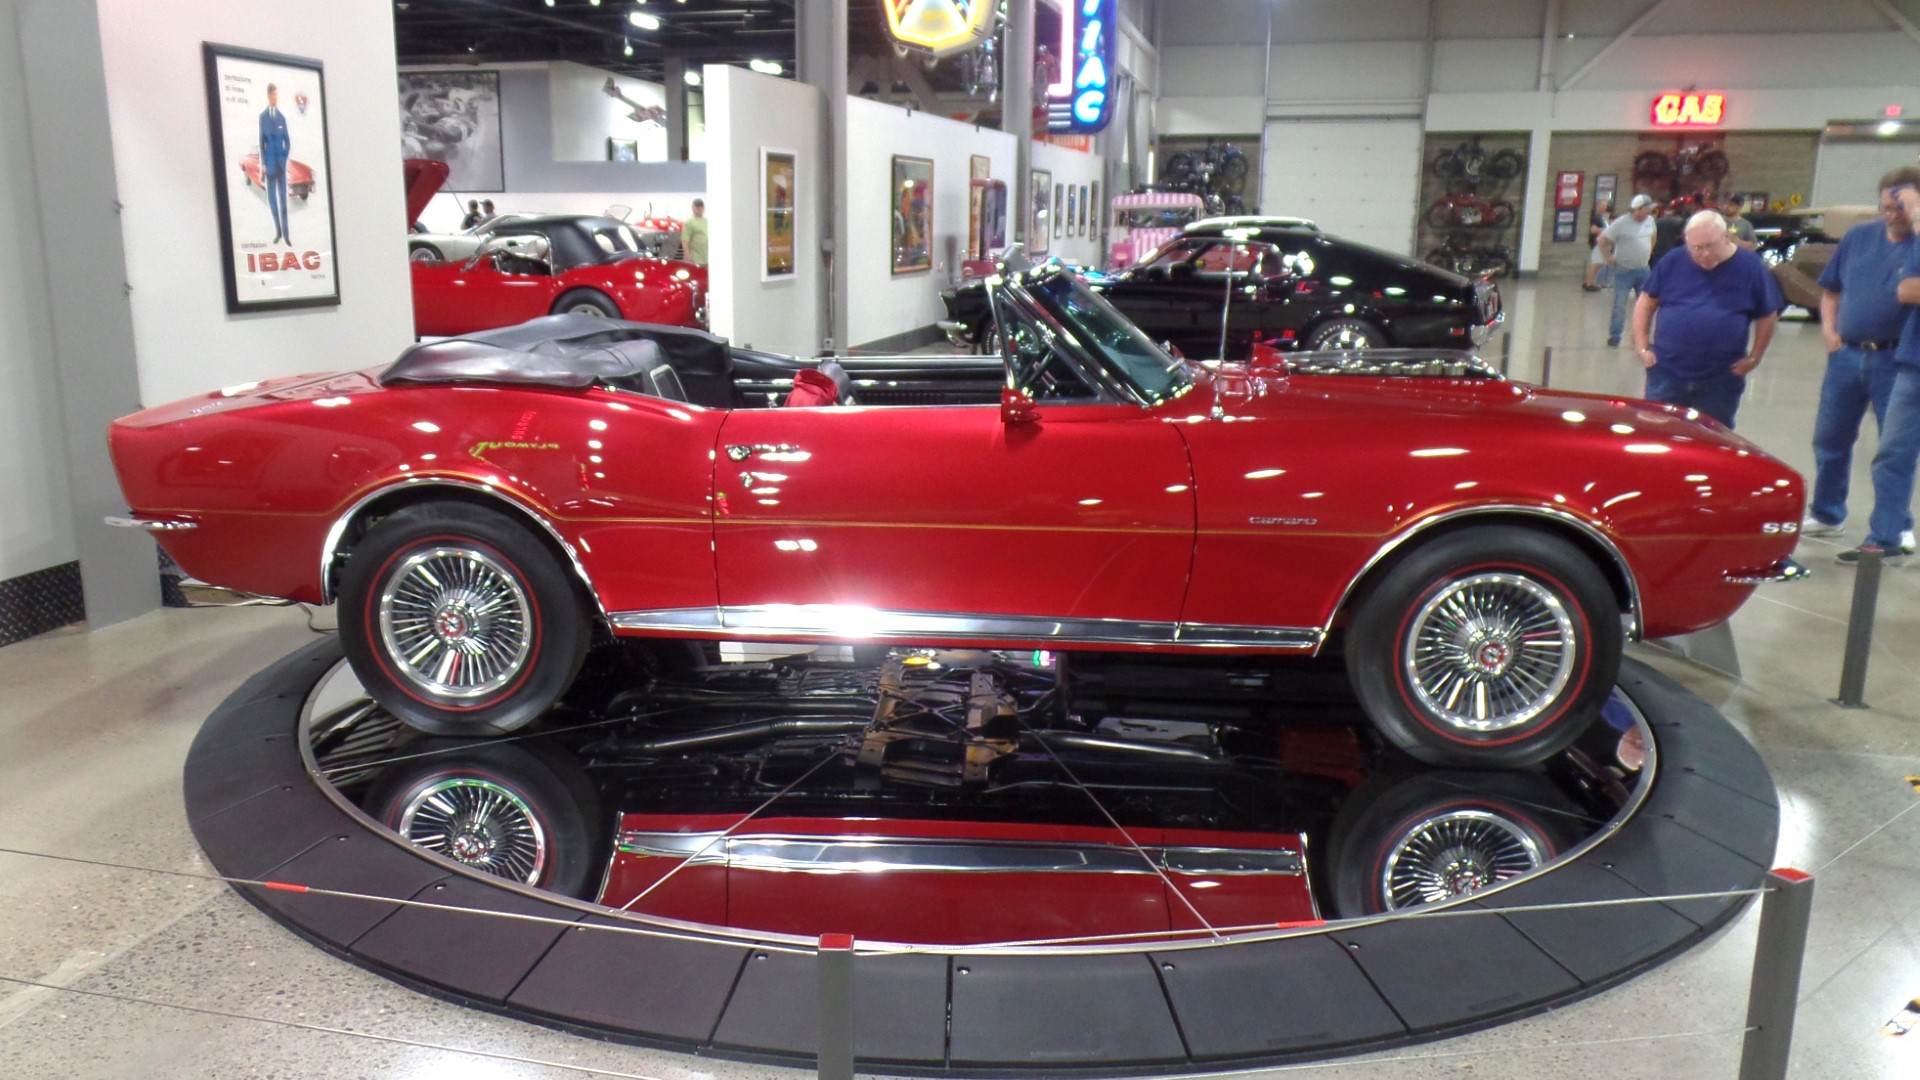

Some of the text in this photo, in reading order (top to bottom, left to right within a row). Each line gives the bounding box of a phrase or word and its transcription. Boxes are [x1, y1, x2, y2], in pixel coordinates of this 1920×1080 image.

[1655, 94, 1723, 124] GAS
[247, 250, 321, 273] IBAC
[1763, 521, 1798, 534] SS
